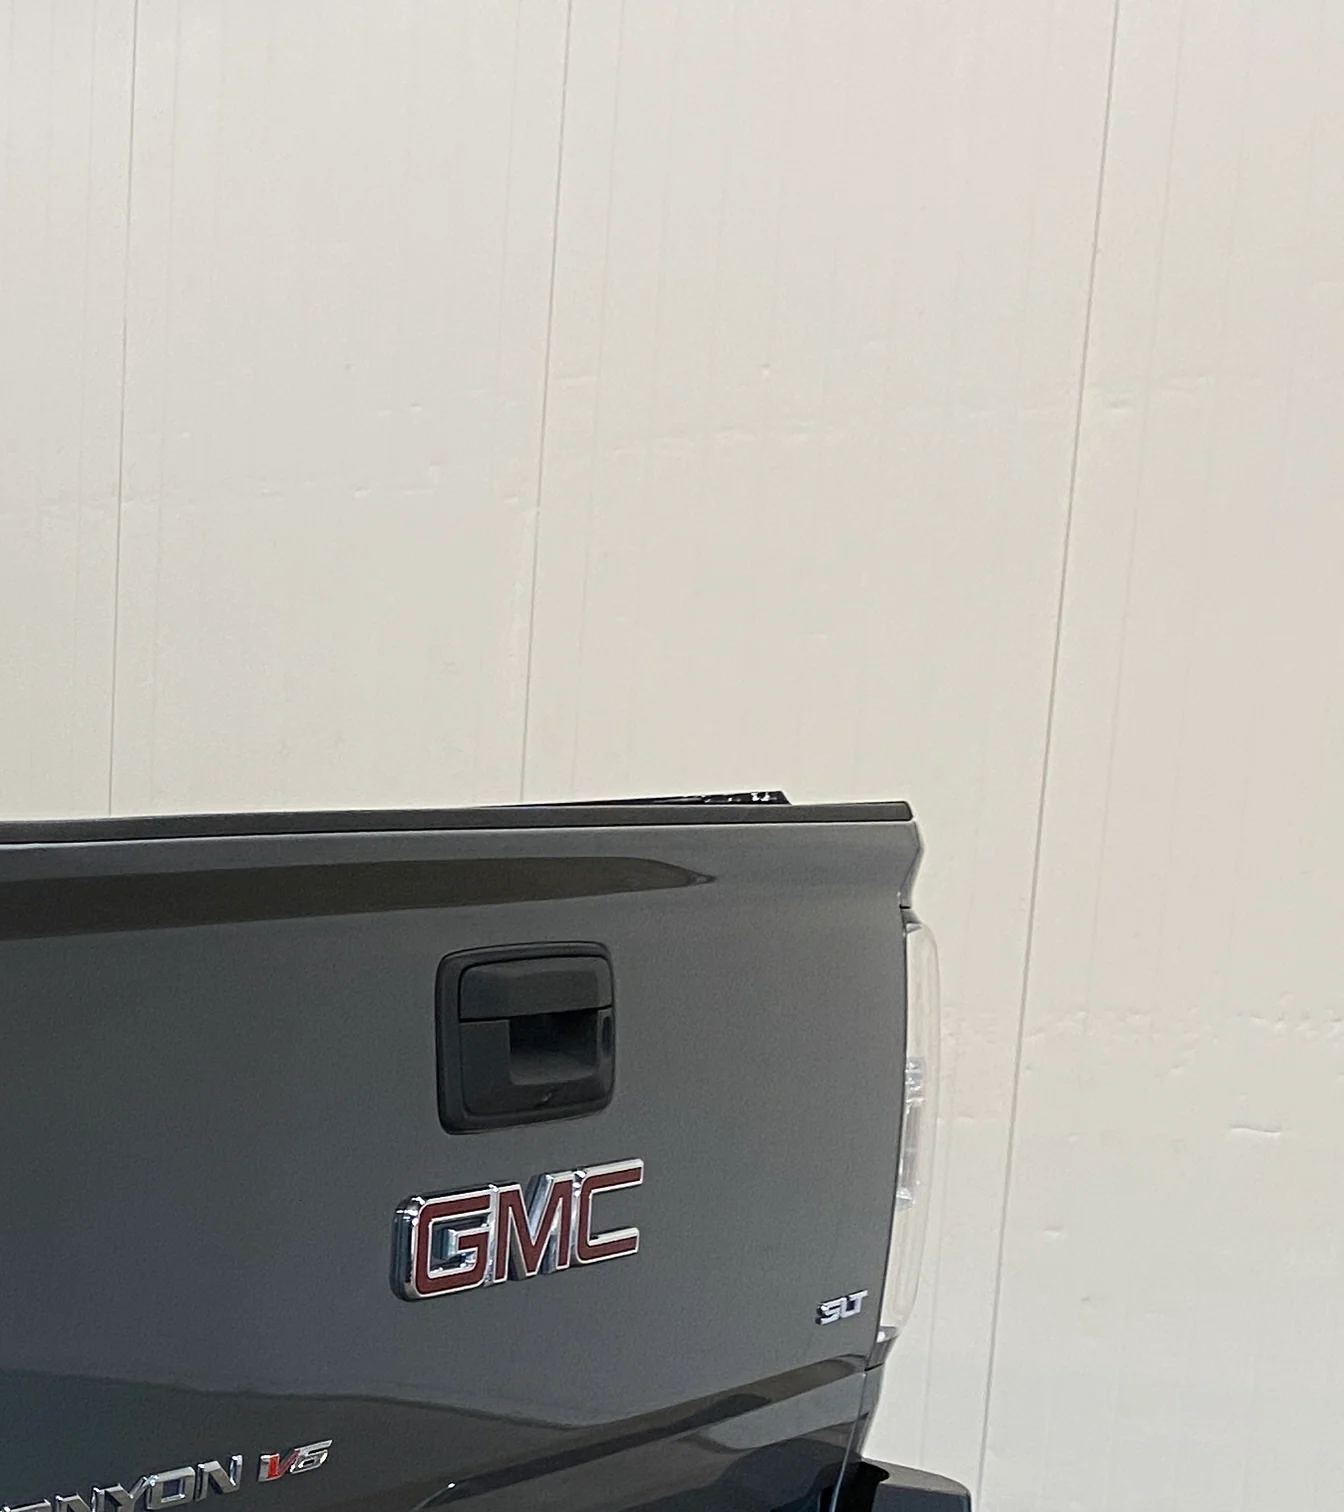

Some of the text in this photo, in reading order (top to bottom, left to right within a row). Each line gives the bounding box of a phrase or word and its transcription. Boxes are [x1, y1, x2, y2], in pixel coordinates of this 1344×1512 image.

[394, 1158, 644, 1300] GMC
[815, 1290, 868, 1326] SLT
[257, 1439, 333, 1482] V6
